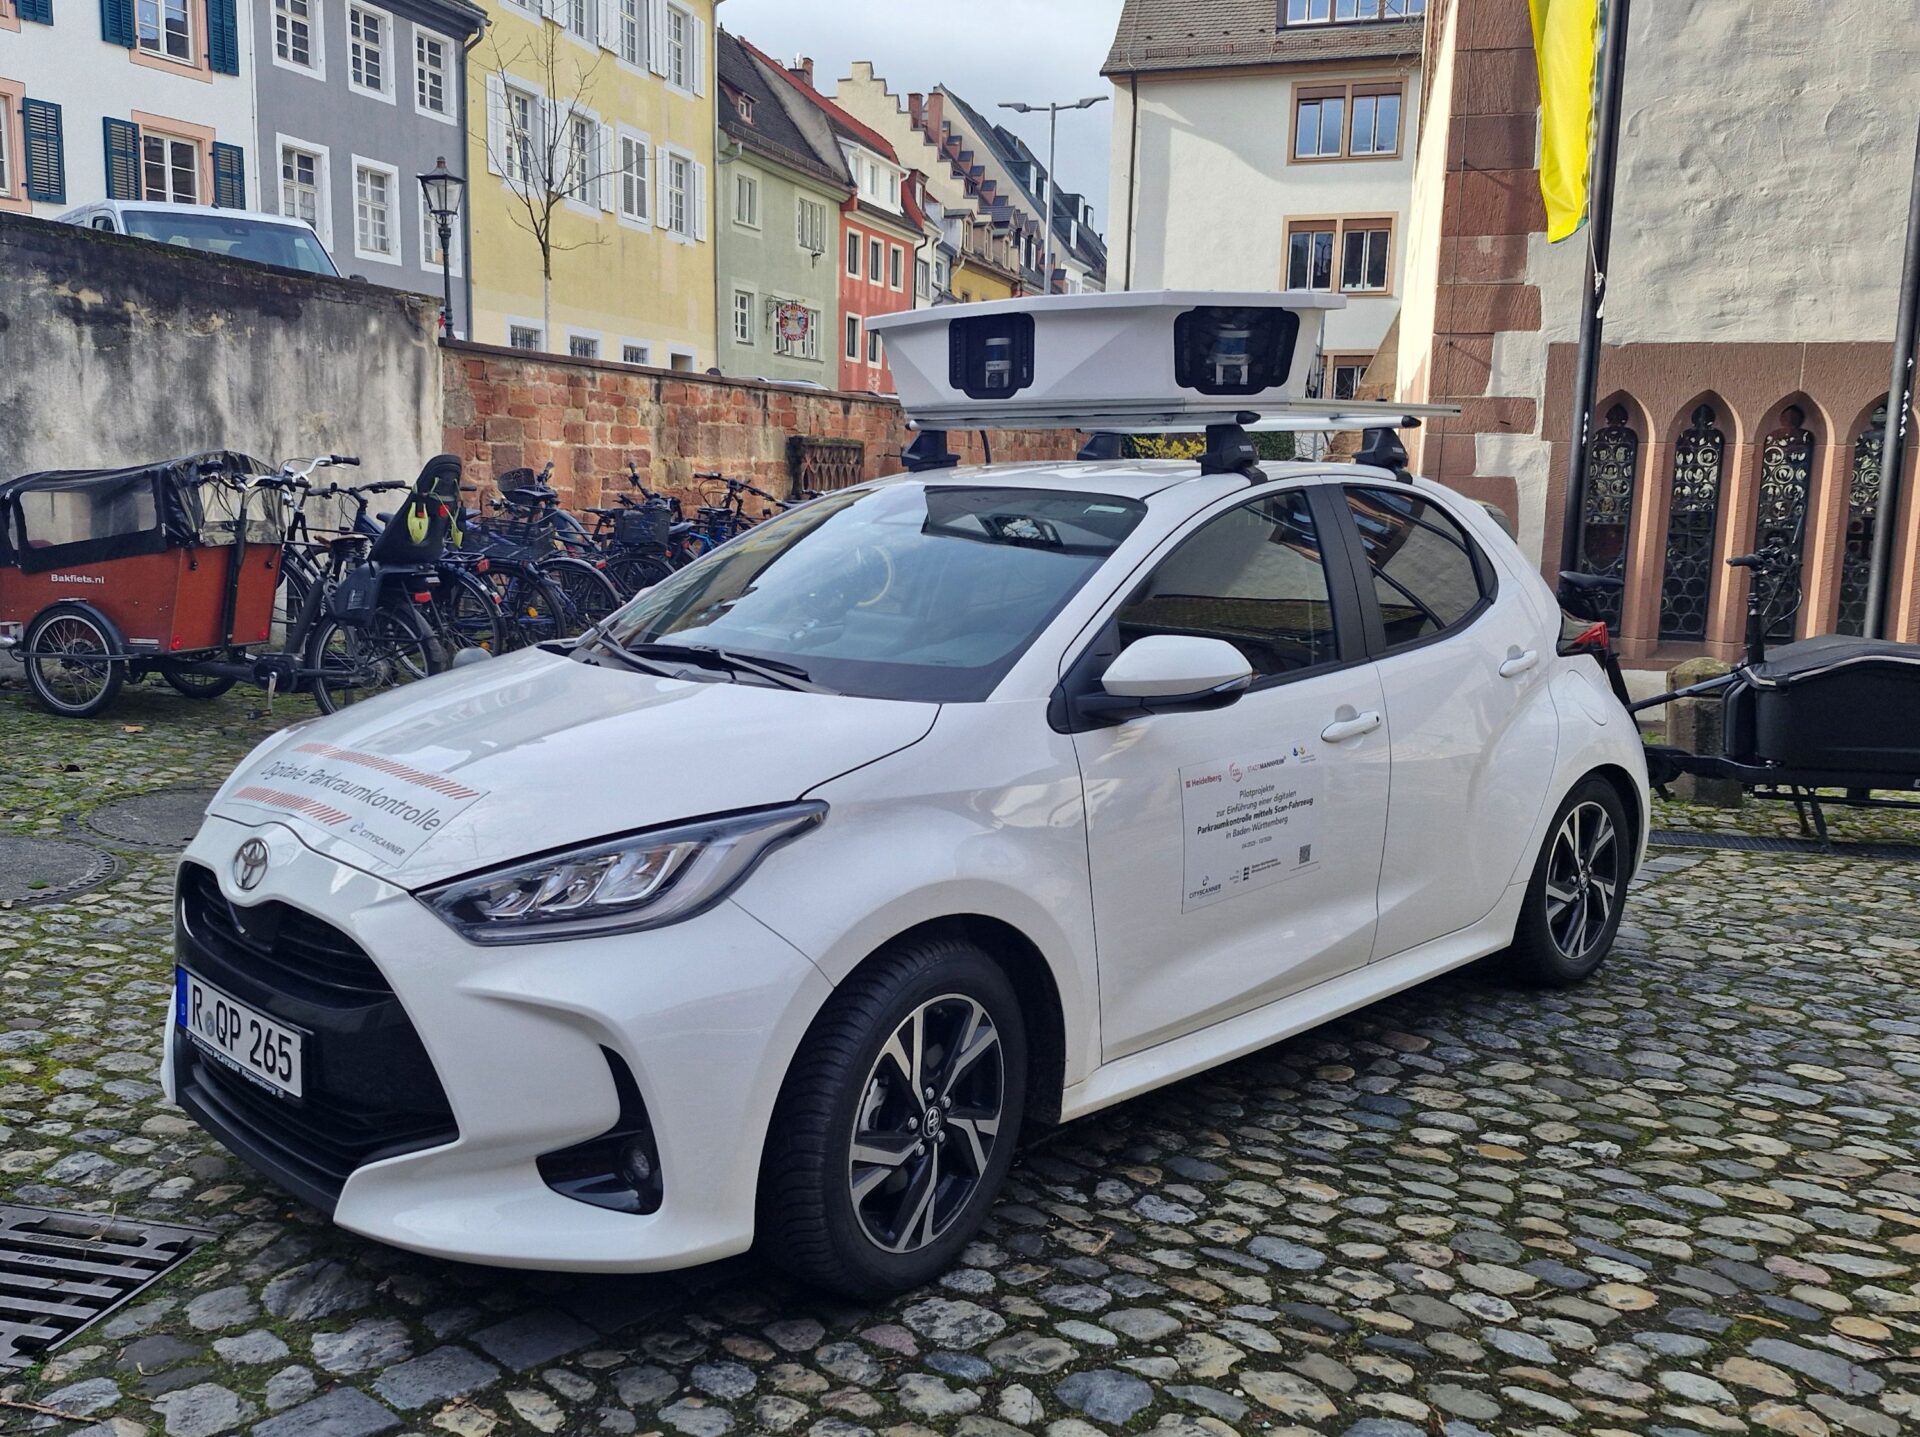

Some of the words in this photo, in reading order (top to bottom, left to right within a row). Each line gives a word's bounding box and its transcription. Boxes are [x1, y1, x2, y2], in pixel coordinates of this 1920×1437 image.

[51, 573, 104, 584] Bakfiets.nl
[1191, 773, 1222, 788] Heidelberg
[1240, 784, 1275, 799] Pilotprojekte
[260, 761, 307, 780] Digitale
[303, 769, 441, 831] Parkraumkontrolle
[1216, 809, 1226, 818] zur
[1227, 801, 1257, 815] Einführung
[1258, 797, 1272, 806] einer
[1273, 790, 1296, 803] digitalen
[1197, 813, 1252, 834] Parkraumkontrolle
[1253, 808, 1273, 820] mittels
[1274, 798, 1313, 814] Scan-Fahrzeug
[1226, 831, 1232, 839] in
[1232, 816, 1288, 837] Baden-Württemberg
[361, 828, 405, 857] CITYSCANNER
[1189, 884, 1221, 899] CITYSCANNER
[193, 984, 202, 1031] R
[216, 1000, 241, 1051] QP
[250, 1019, 292, 1082] 265
